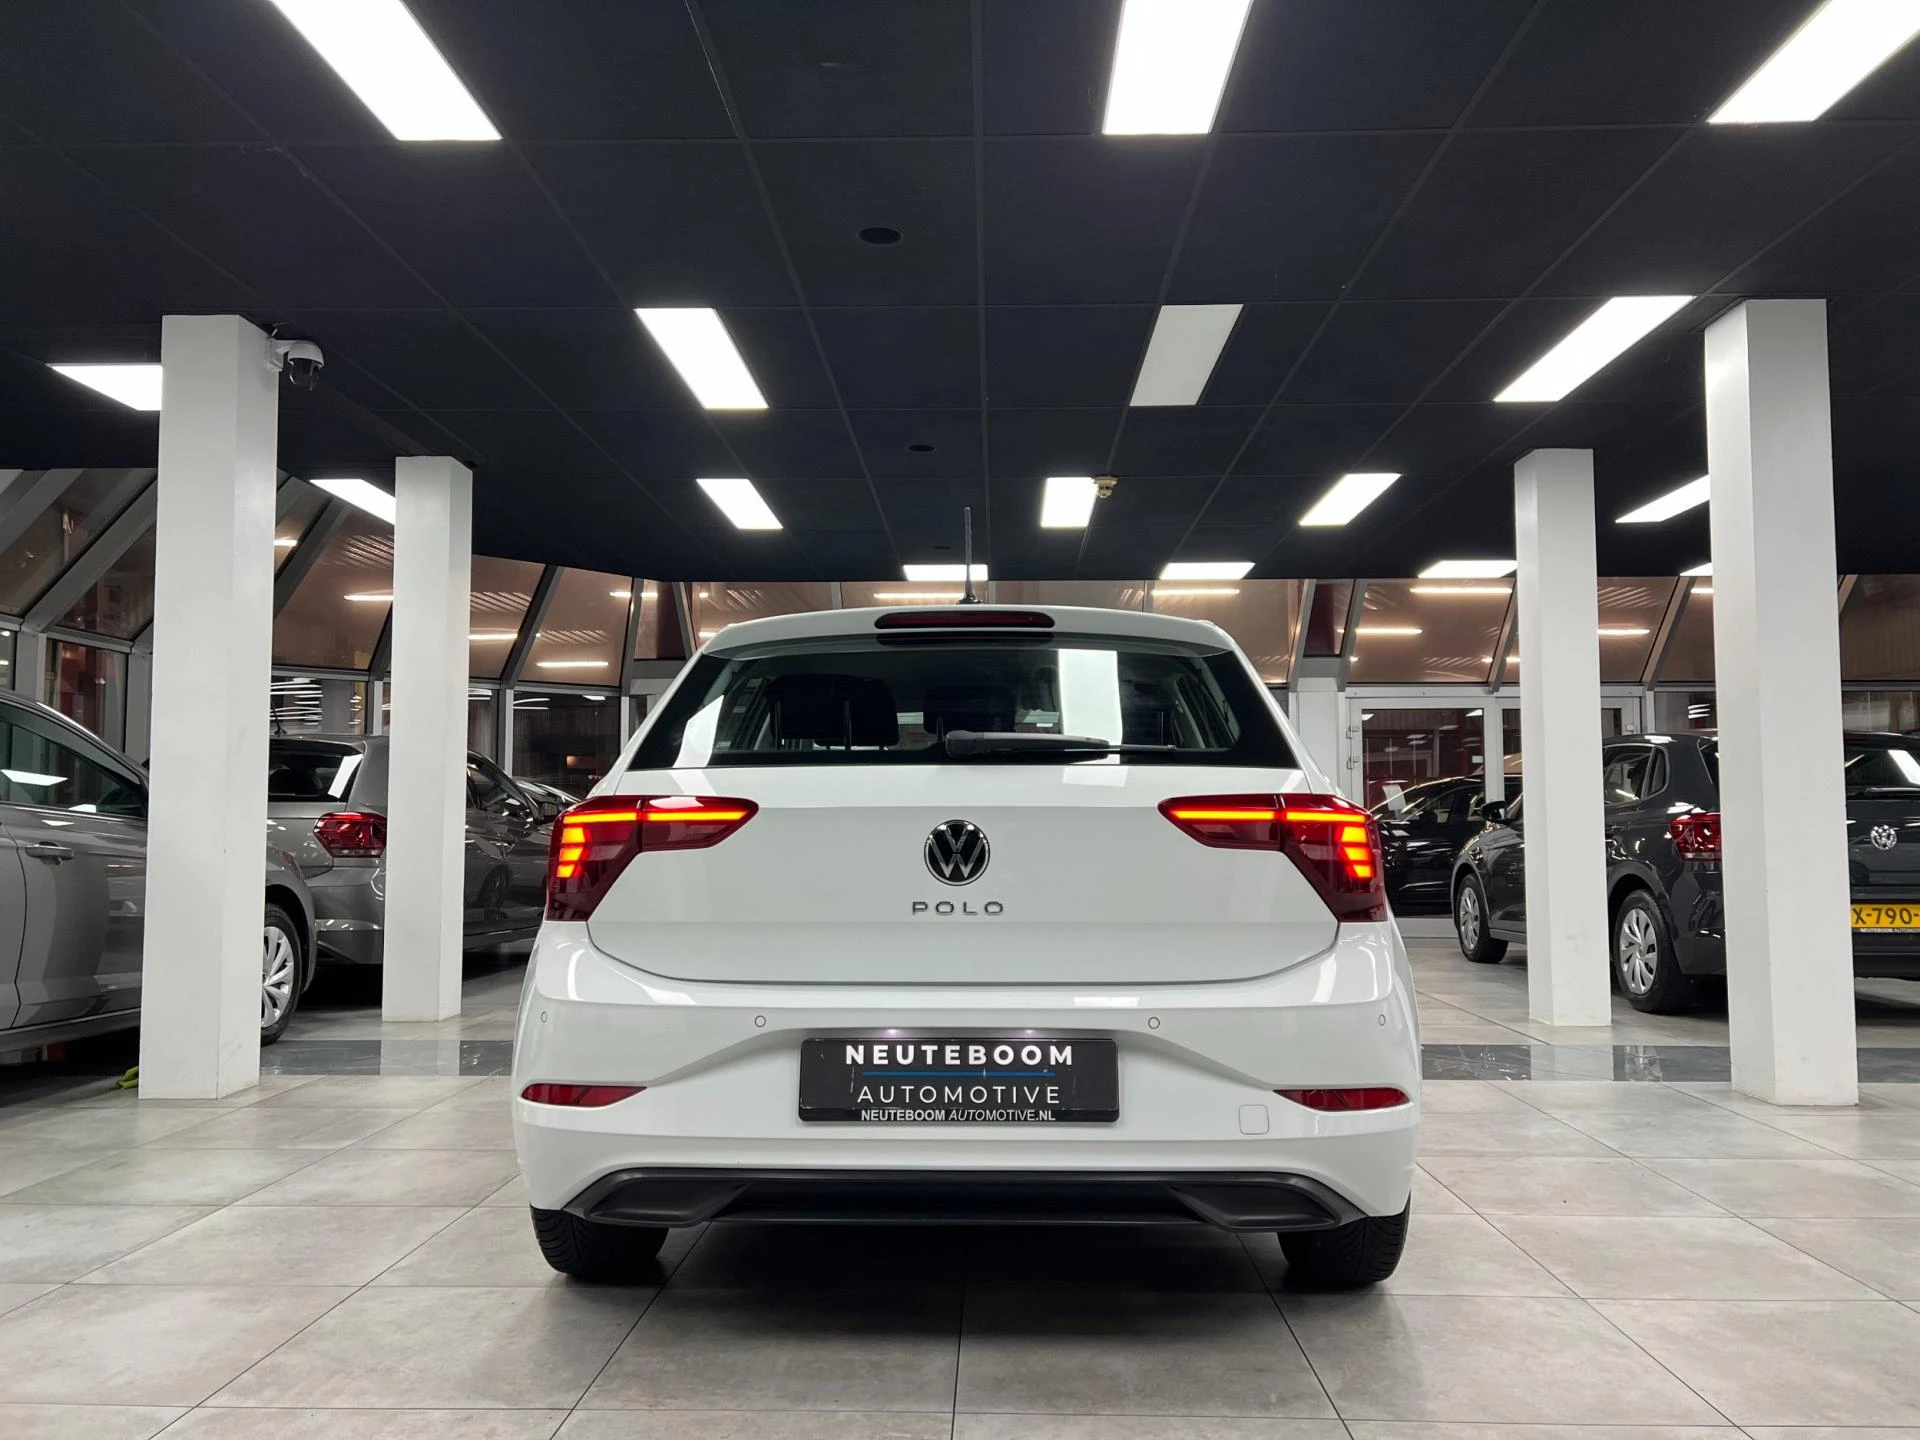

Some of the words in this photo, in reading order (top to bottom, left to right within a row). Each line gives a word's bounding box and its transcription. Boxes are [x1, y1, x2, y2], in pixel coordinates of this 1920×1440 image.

[912, 901, 1004, 915] POLO
[846, 1045, 1072, 1065] NEUTEBOOM
[857, 1086, 1060, 1104] AUTOMOTIVE
[861, 1109, 945, 1121] NEUTEBOOM
[948, 1109, 1056, 1121] AUTOMOTIVE.NL
